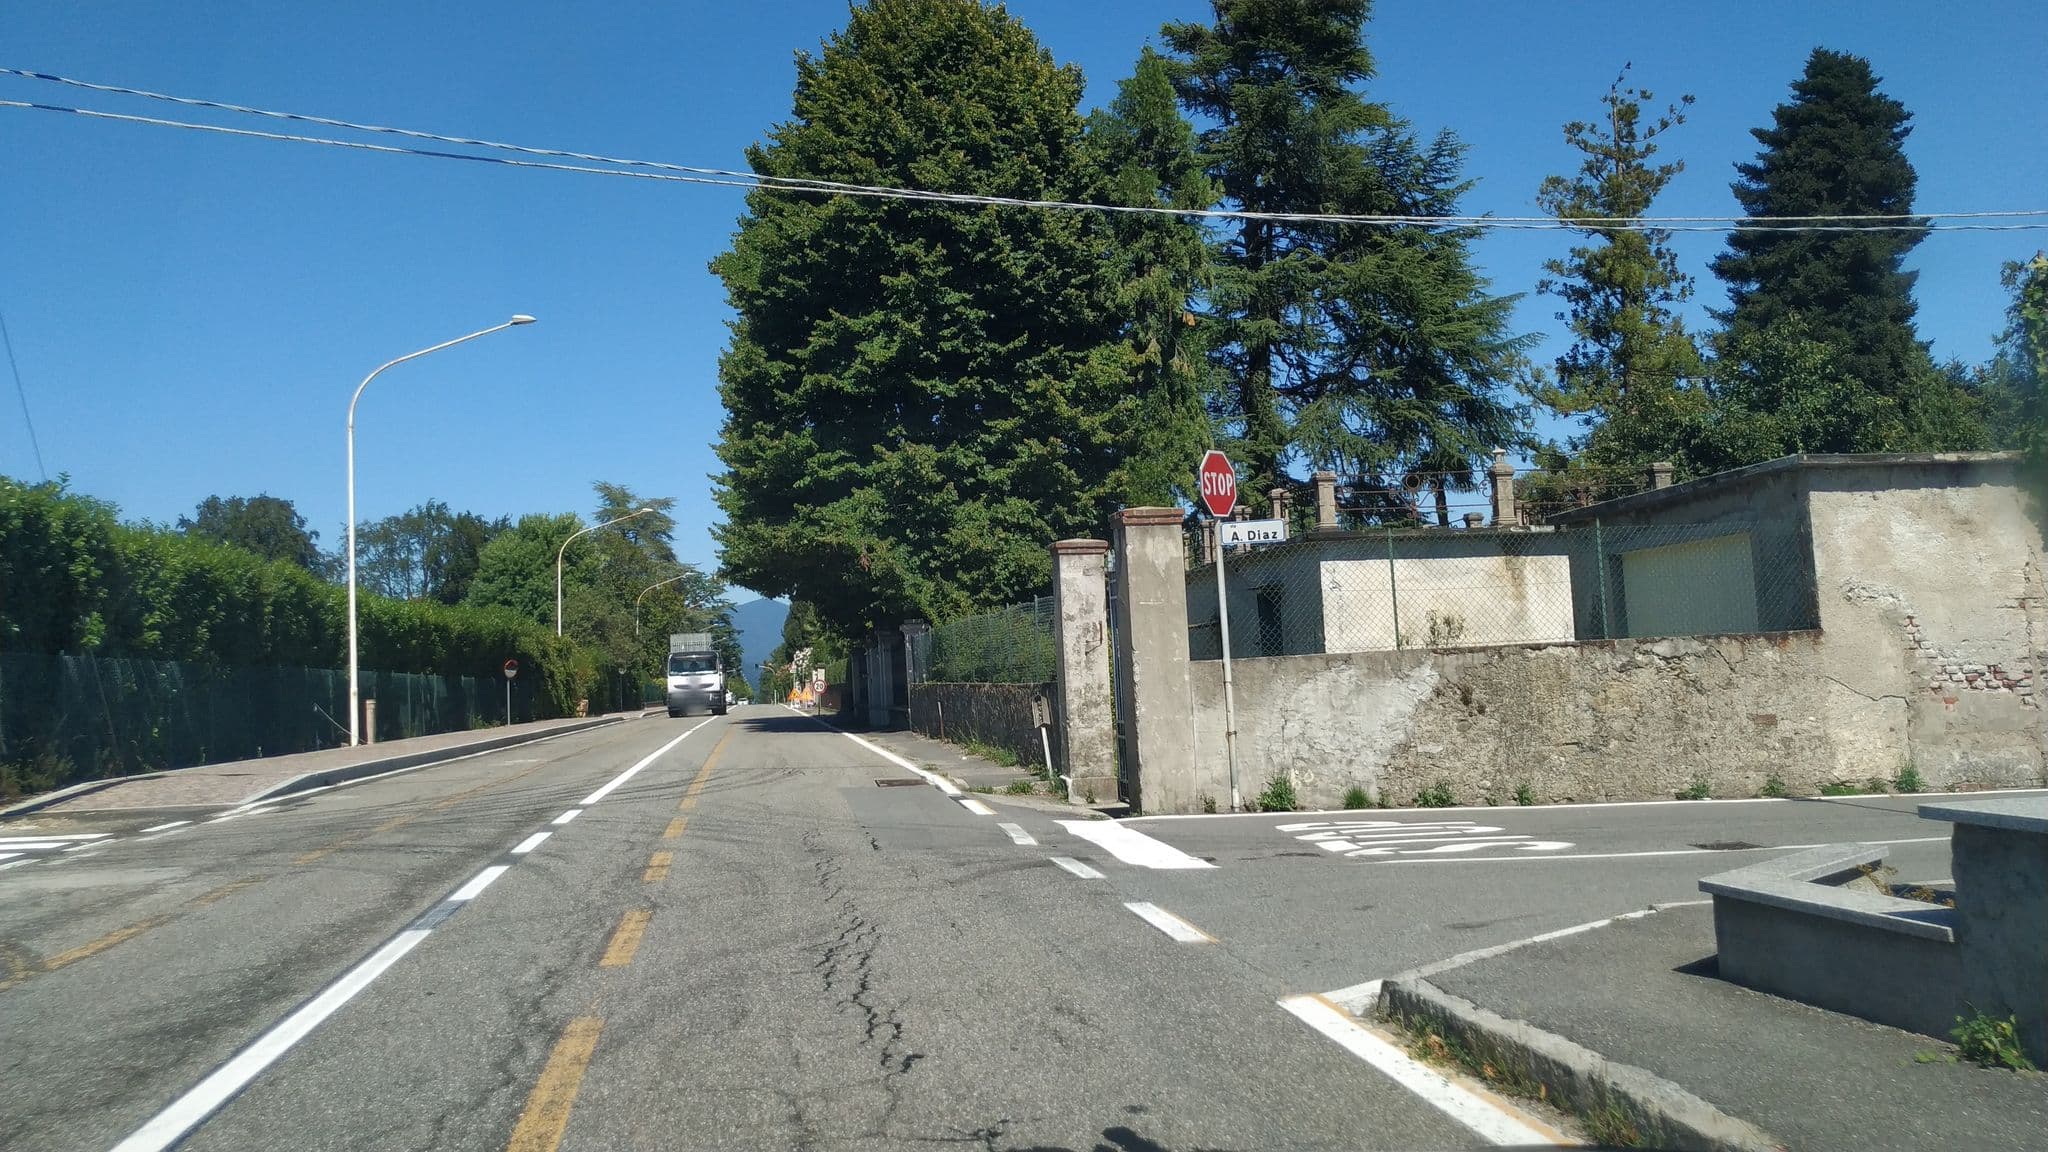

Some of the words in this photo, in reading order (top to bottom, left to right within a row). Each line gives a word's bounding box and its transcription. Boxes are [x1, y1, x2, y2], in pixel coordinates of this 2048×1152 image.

[1204, 472, 1233, 496] STOP
[1231, 531, 1243, 542] A.
[1247, 530, 1278, 541] Diaz
[1274, 821, 1577, 857] STOP
